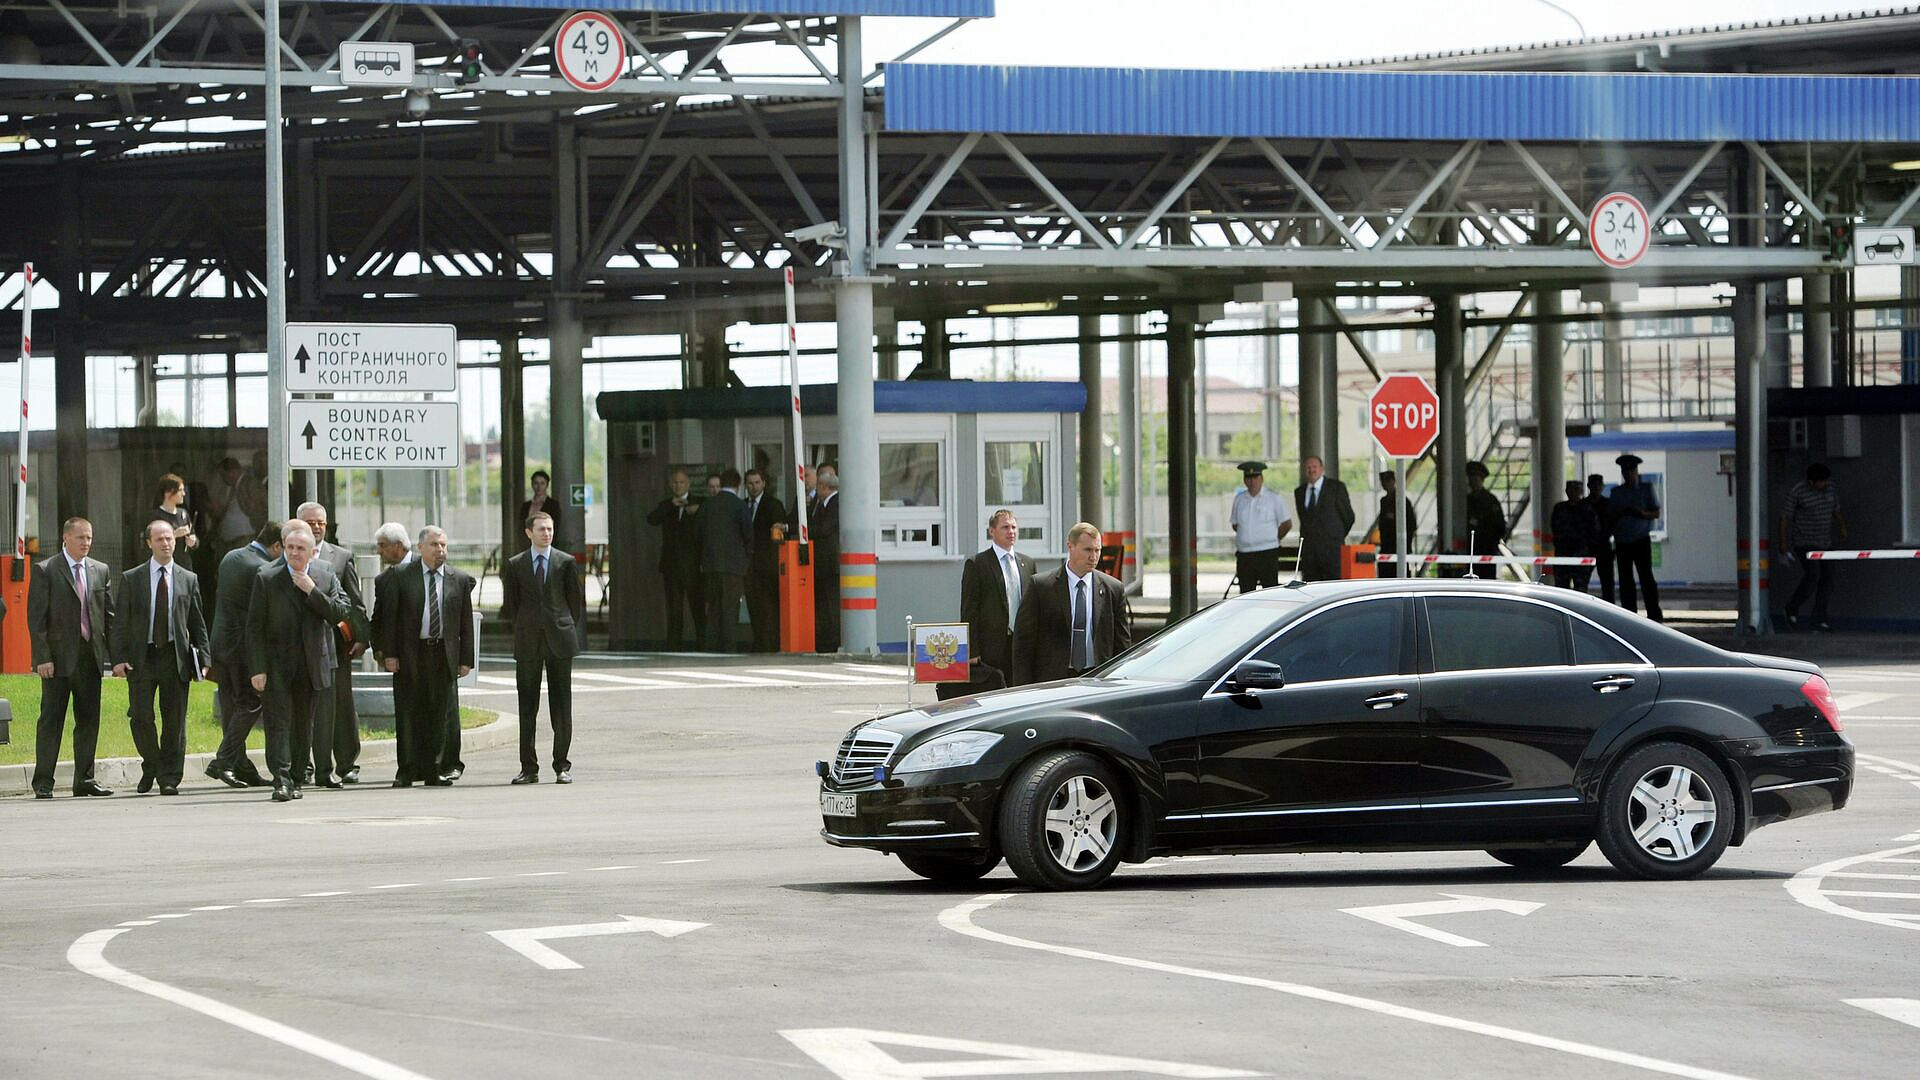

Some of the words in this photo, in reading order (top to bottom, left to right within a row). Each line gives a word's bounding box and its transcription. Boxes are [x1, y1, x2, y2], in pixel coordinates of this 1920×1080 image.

[317, 332, 361, 347] ПОСТ
[318, 352, 447, 366] ПОГРАНИЧНОГО
[318, 370, 408, 385] КОНТРОЛЯ
[328, 409, 428, 423] BOUNDARY
[1374, 402, 1435, 430] STOP
[329, 428, 413, 442] CONTROL
[329, 446, 387, 461] CHECK
[395, 447, 447, 461] POINT
